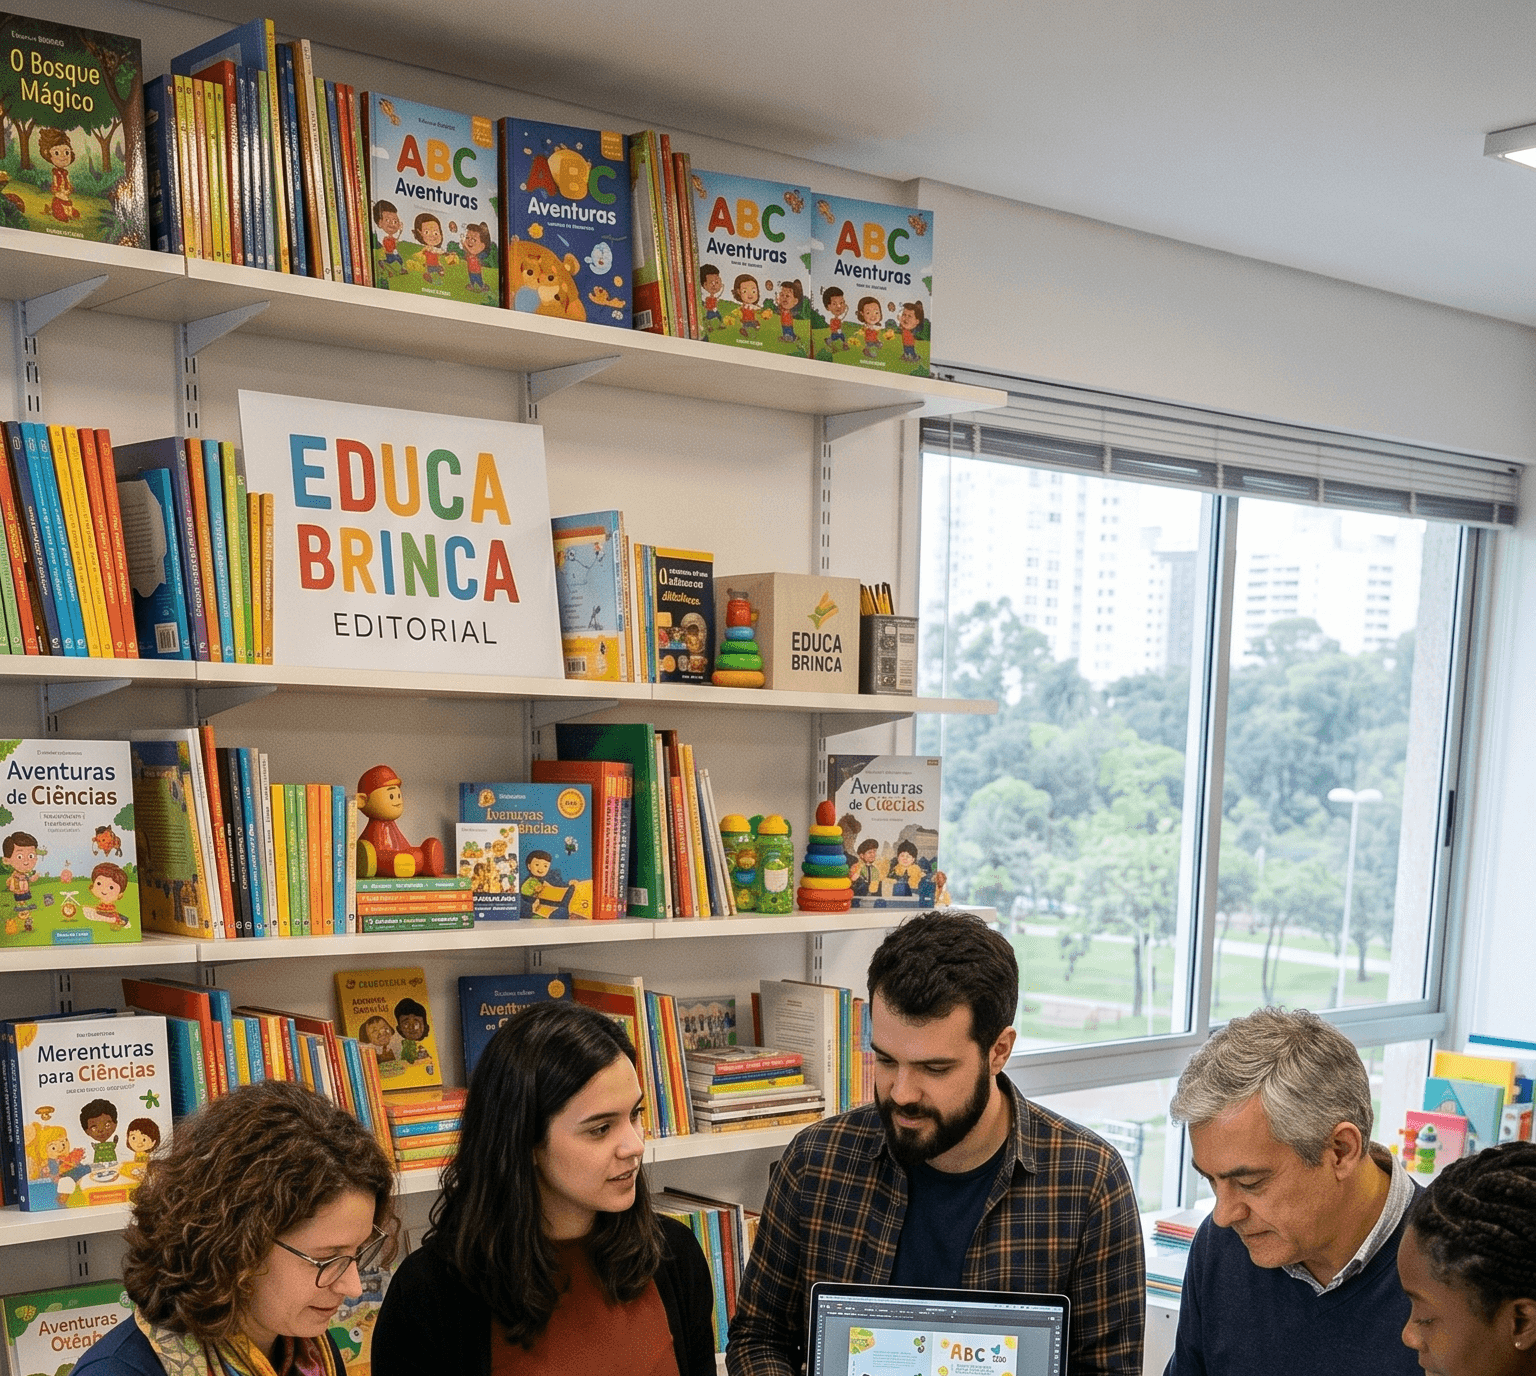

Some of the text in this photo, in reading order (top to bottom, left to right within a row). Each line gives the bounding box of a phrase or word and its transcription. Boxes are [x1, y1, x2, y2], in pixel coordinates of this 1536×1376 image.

[10, 48, 100, 88] O Bosque
[21, 77, 94, 114] Mágico
[397, 134, 478, 188] ABC
[525, 155, 616, 205] ABC
[394, 177, 478, 211] Aventuras
[528, 196, 617, 225] Aventuras
[708, 196, 786, 243] ABC
[706, 237, 787, 264] Aventuras
[835, 220, 910, 265] ABC
[834, 259, 911, 285] Aventuras
[288, 433, 512, 526] EDUCA
[297, 523, 520, 604] BRINCA
[333, 612, 498, 645] EDITORIAL
[791, 631, 843, 654] EDUCA
[791, 654, 843, 673] BRINCA
[6, 760, 116, 781] Aventuras
[6, 788, 27, 805] de
[850, 777, 923, 795] Aventuras
[849, 799, 863, 810] de
[37, 1042, 154, 1063] Merenturas
[38, 1071, 75, 1088] para
[38, 1313, 118, 1337] Aventuras
[950, 1343, 985, 1363] ABC
